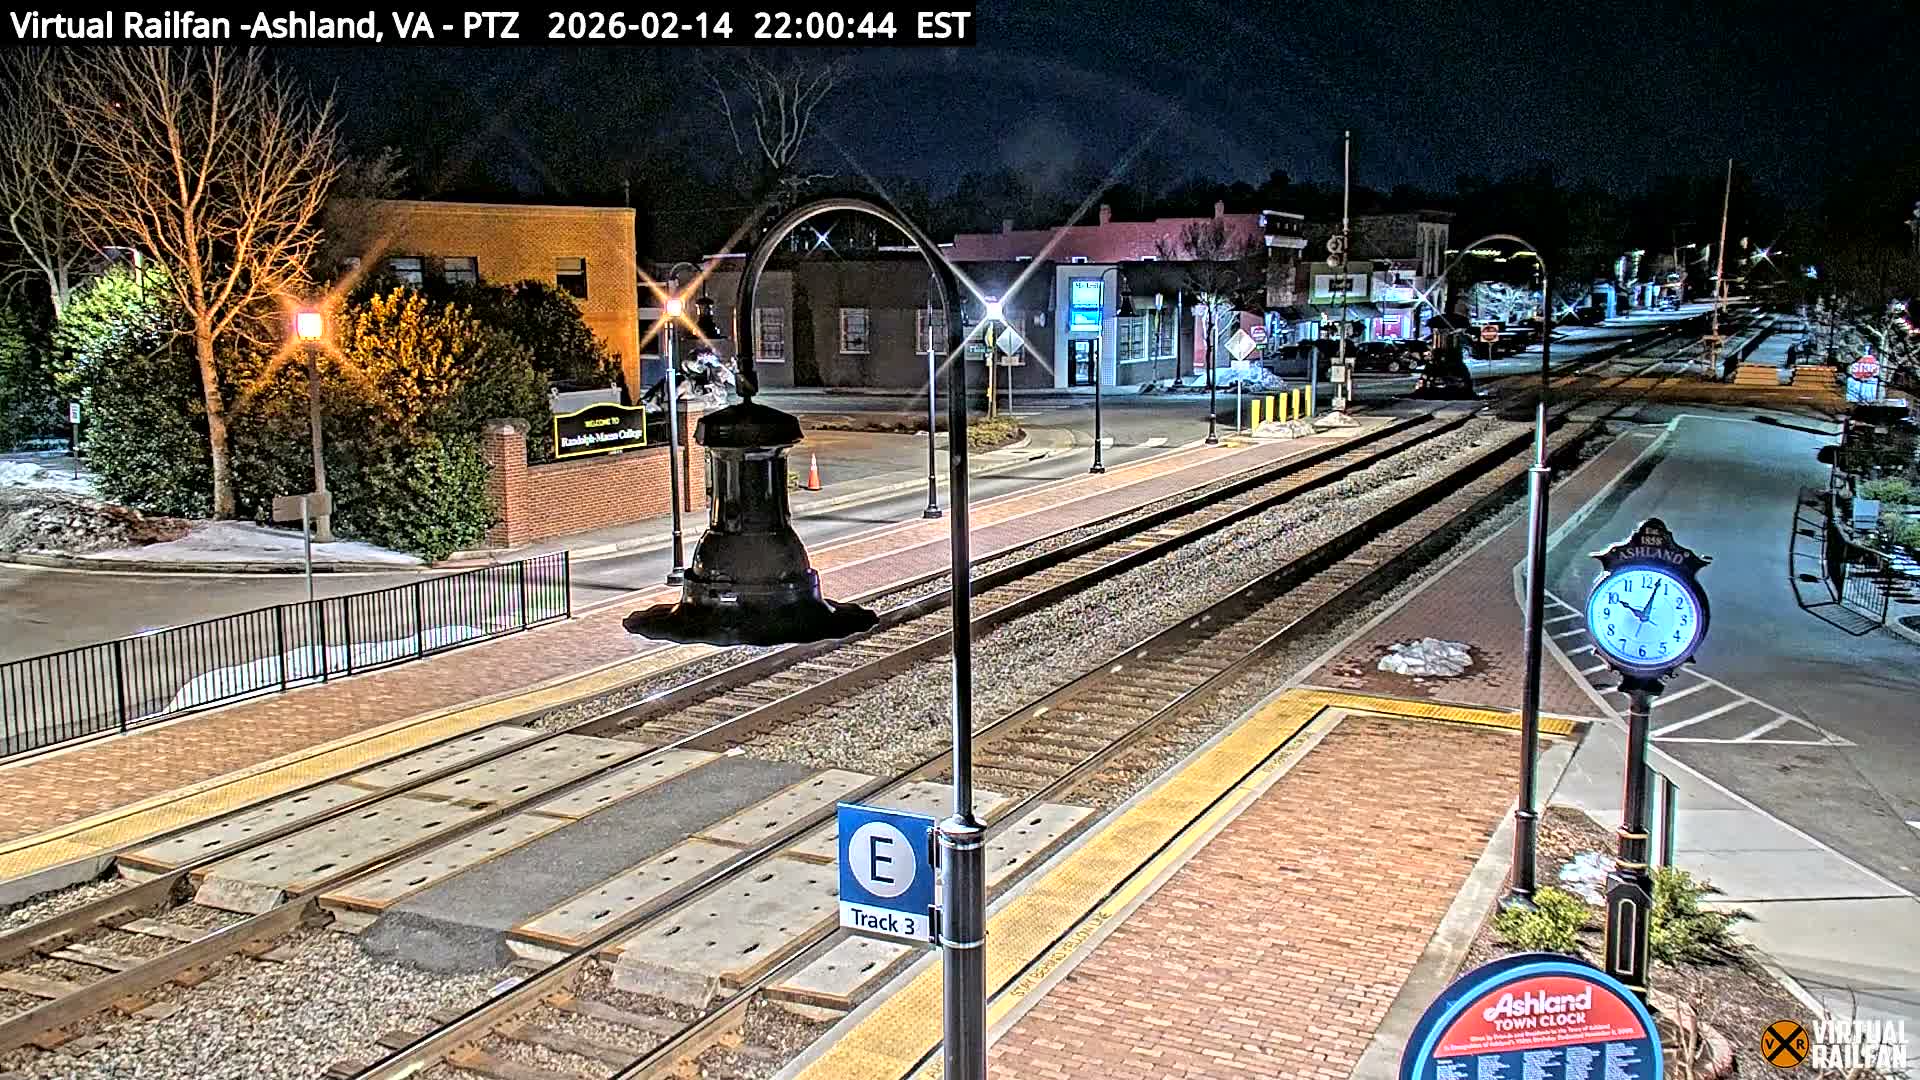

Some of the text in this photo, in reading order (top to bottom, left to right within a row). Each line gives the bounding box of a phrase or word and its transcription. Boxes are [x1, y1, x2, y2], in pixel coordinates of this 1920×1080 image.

[1851, 362, 1879, 373] STOP
[1618, 545, 1685, 565] ASHLAND
[1623, 579, 1633, 593] 11
[1641, 575, 1653, 590] 12
[1663, 583, 1669, 596] 1
[1608, 592, 1620, 605] 10
[1675, 597, 1684, 610] 2
[1603, 607, 1611, 620] 9
[1679, 614, 1688, 627] 3
[1606, 623, 1615, 637] 8
[1672, 630, 1681, 643] 4
[1618, 638, 1627, 651] 7
[1638, 644, 1647, 657] 6
[1659, 641, 1668, 655] 5
[869, 835, 895, 884] E
[850, 907, 915, 935] Track 3
[1483, 985, 1592, 1022] Ashland
[1494, 1012, 1586, 1032] TOWN CLOCK
